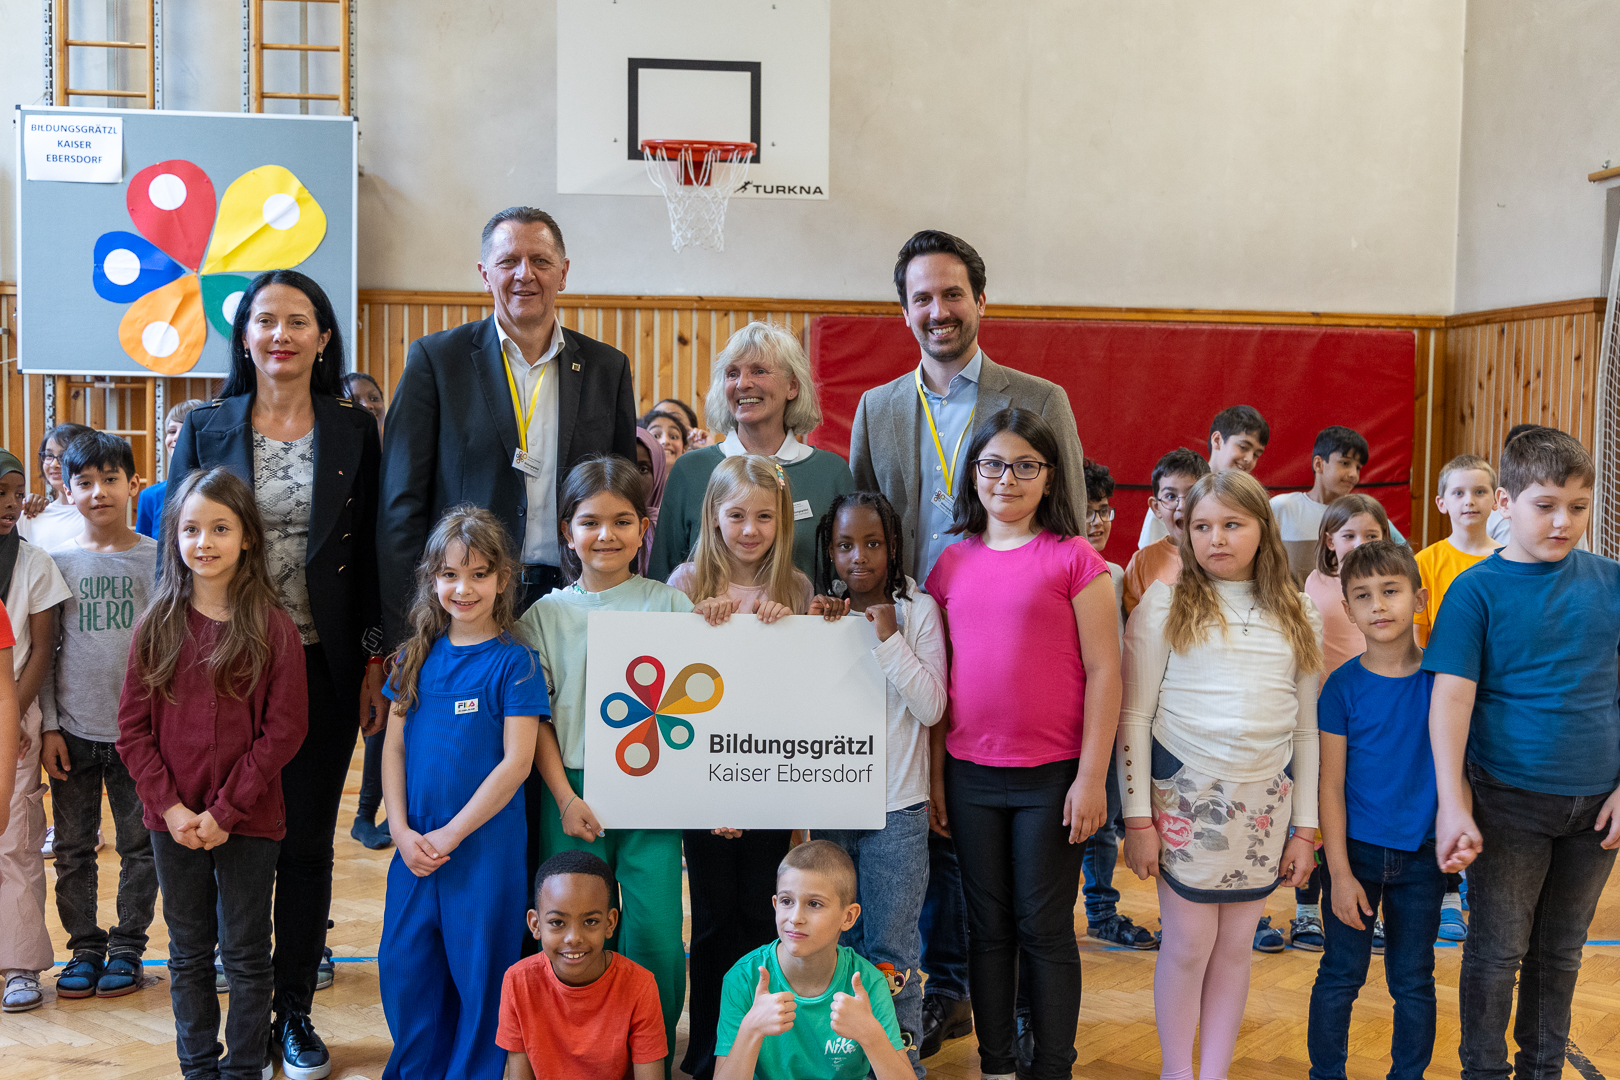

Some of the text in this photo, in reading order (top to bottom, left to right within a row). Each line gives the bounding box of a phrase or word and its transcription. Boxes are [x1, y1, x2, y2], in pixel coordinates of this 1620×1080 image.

[31, 124, 118, 134] BILDUNGSGRÄTZL
[57, 140, 92, 149] KAISER
[46, 154, 103, 164] EBERSDORF
[753, 185, 823, 195] TURKNA
[80, 576, 133, 600] SUPER
[79, 600, 133, 632] HERO
[709, 733, 873, 759] Bildungsgrätzl
[709, 763, 873, 782] Kaiser Ebersdorf
